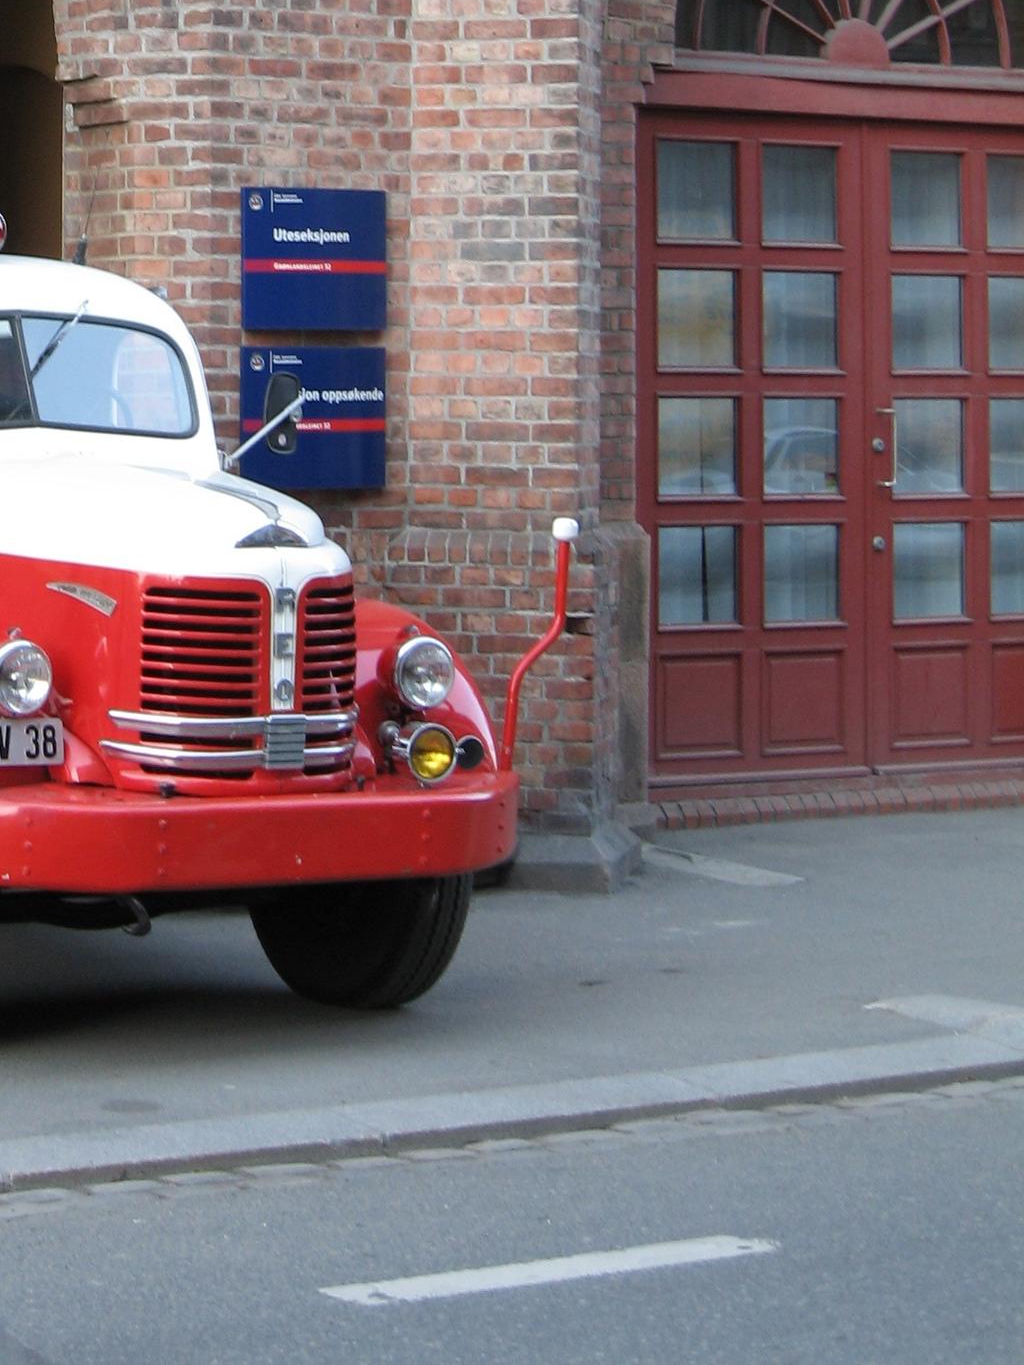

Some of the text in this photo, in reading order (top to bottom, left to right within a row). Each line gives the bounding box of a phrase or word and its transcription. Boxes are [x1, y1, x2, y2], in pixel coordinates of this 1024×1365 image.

[272, 227, 351, 245] Uteseksjonen
[321, 386, 384, 405] oppsøkende
[25, 724, 57, 759] 38
